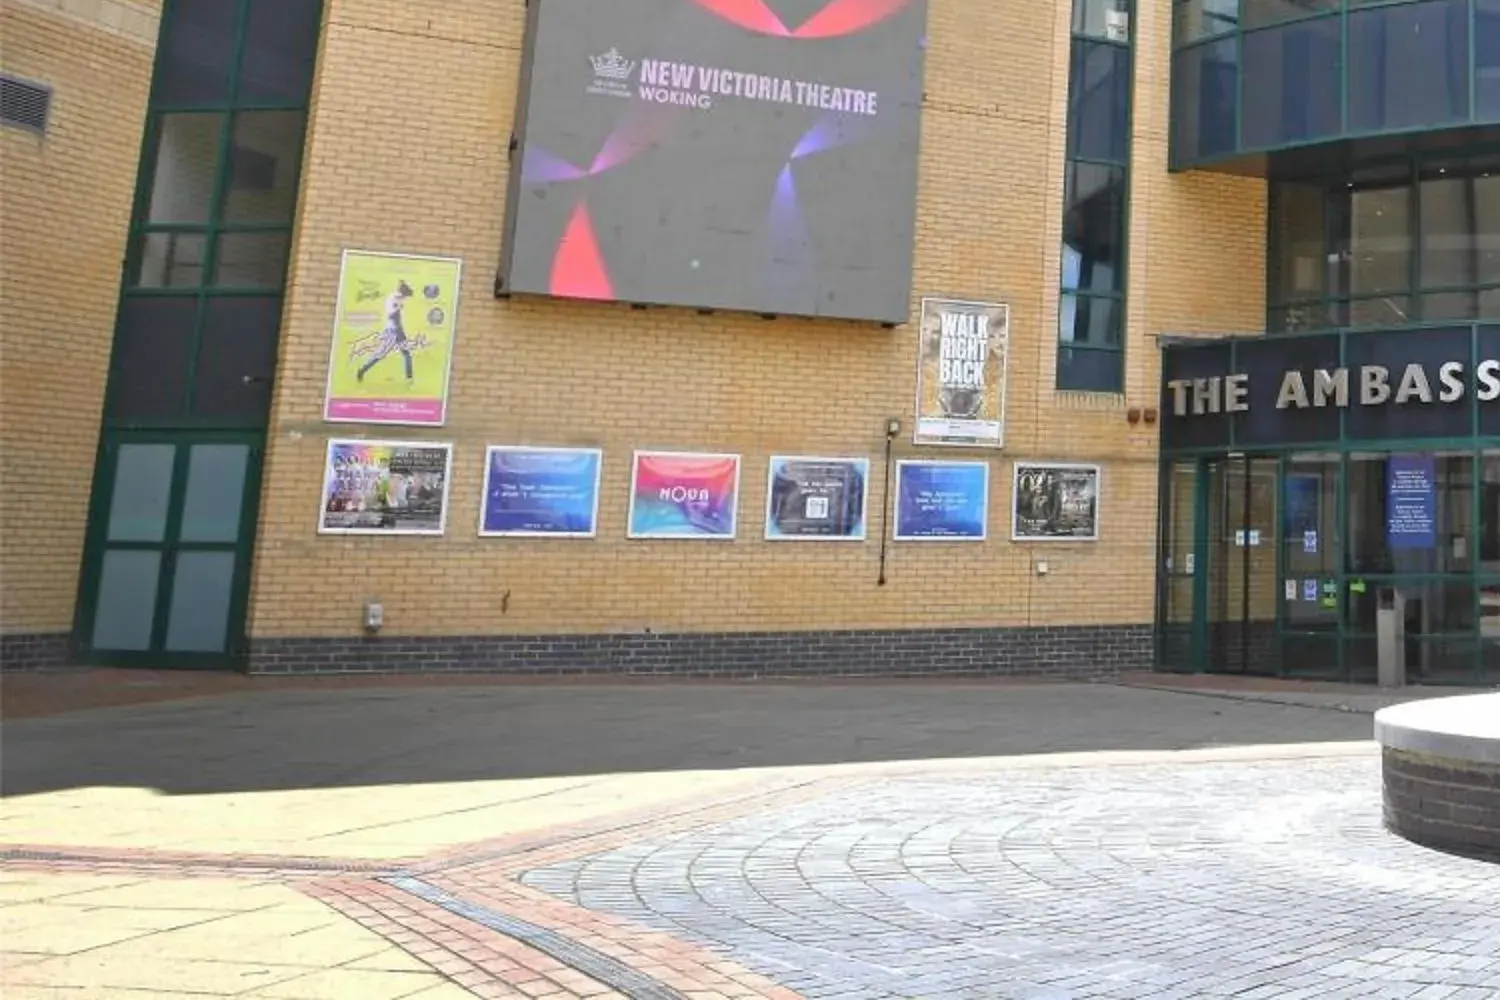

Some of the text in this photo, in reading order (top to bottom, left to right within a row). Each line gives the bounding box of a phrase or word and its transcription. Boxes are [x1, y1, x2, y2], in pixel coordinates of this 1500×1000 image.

[638, 86, 712, 110] WOKING
[639, 58, 699, 90] NEW
[699, 66, 794, 106] VICTORIA
[793, 80, 878, 116] THEATRE
[940, 313, 989, 339] WALK
[940, 337, 988, 361] RIGHT
[940, 359, 986, 385] BACK
[1167, 373, 1249, 417] THE
